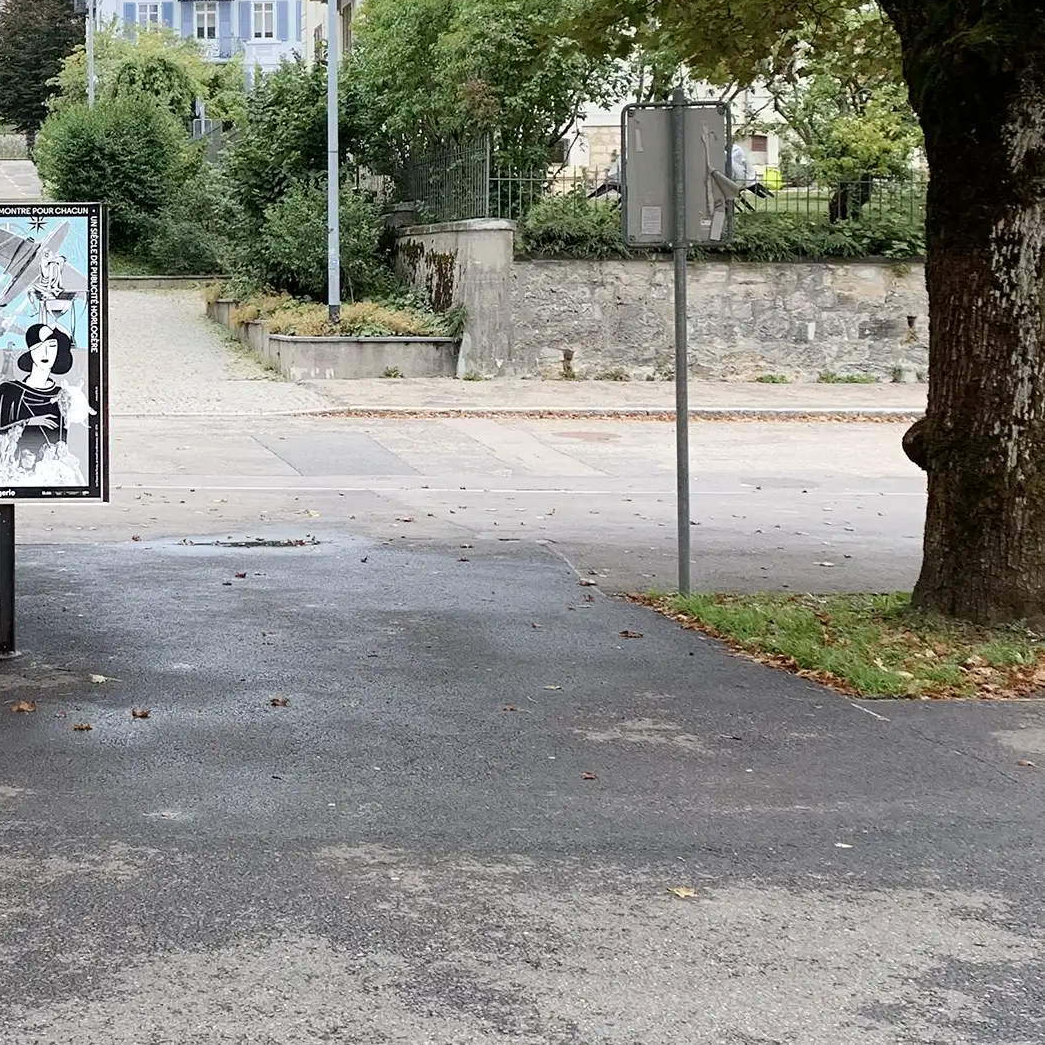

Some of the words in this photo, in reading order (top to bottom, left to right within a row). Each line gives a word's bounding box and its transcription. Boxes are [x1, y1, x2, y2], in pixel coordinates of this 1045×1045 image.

[90, 216, 98, 228] UN
[90, 228, 99, 254] SIÈCLE
[90, 256, 98, 266] DE
[90, 267, 99, 304] PUBLICITÉ
[90, 306, 100, 352] HORLOGÈRE
